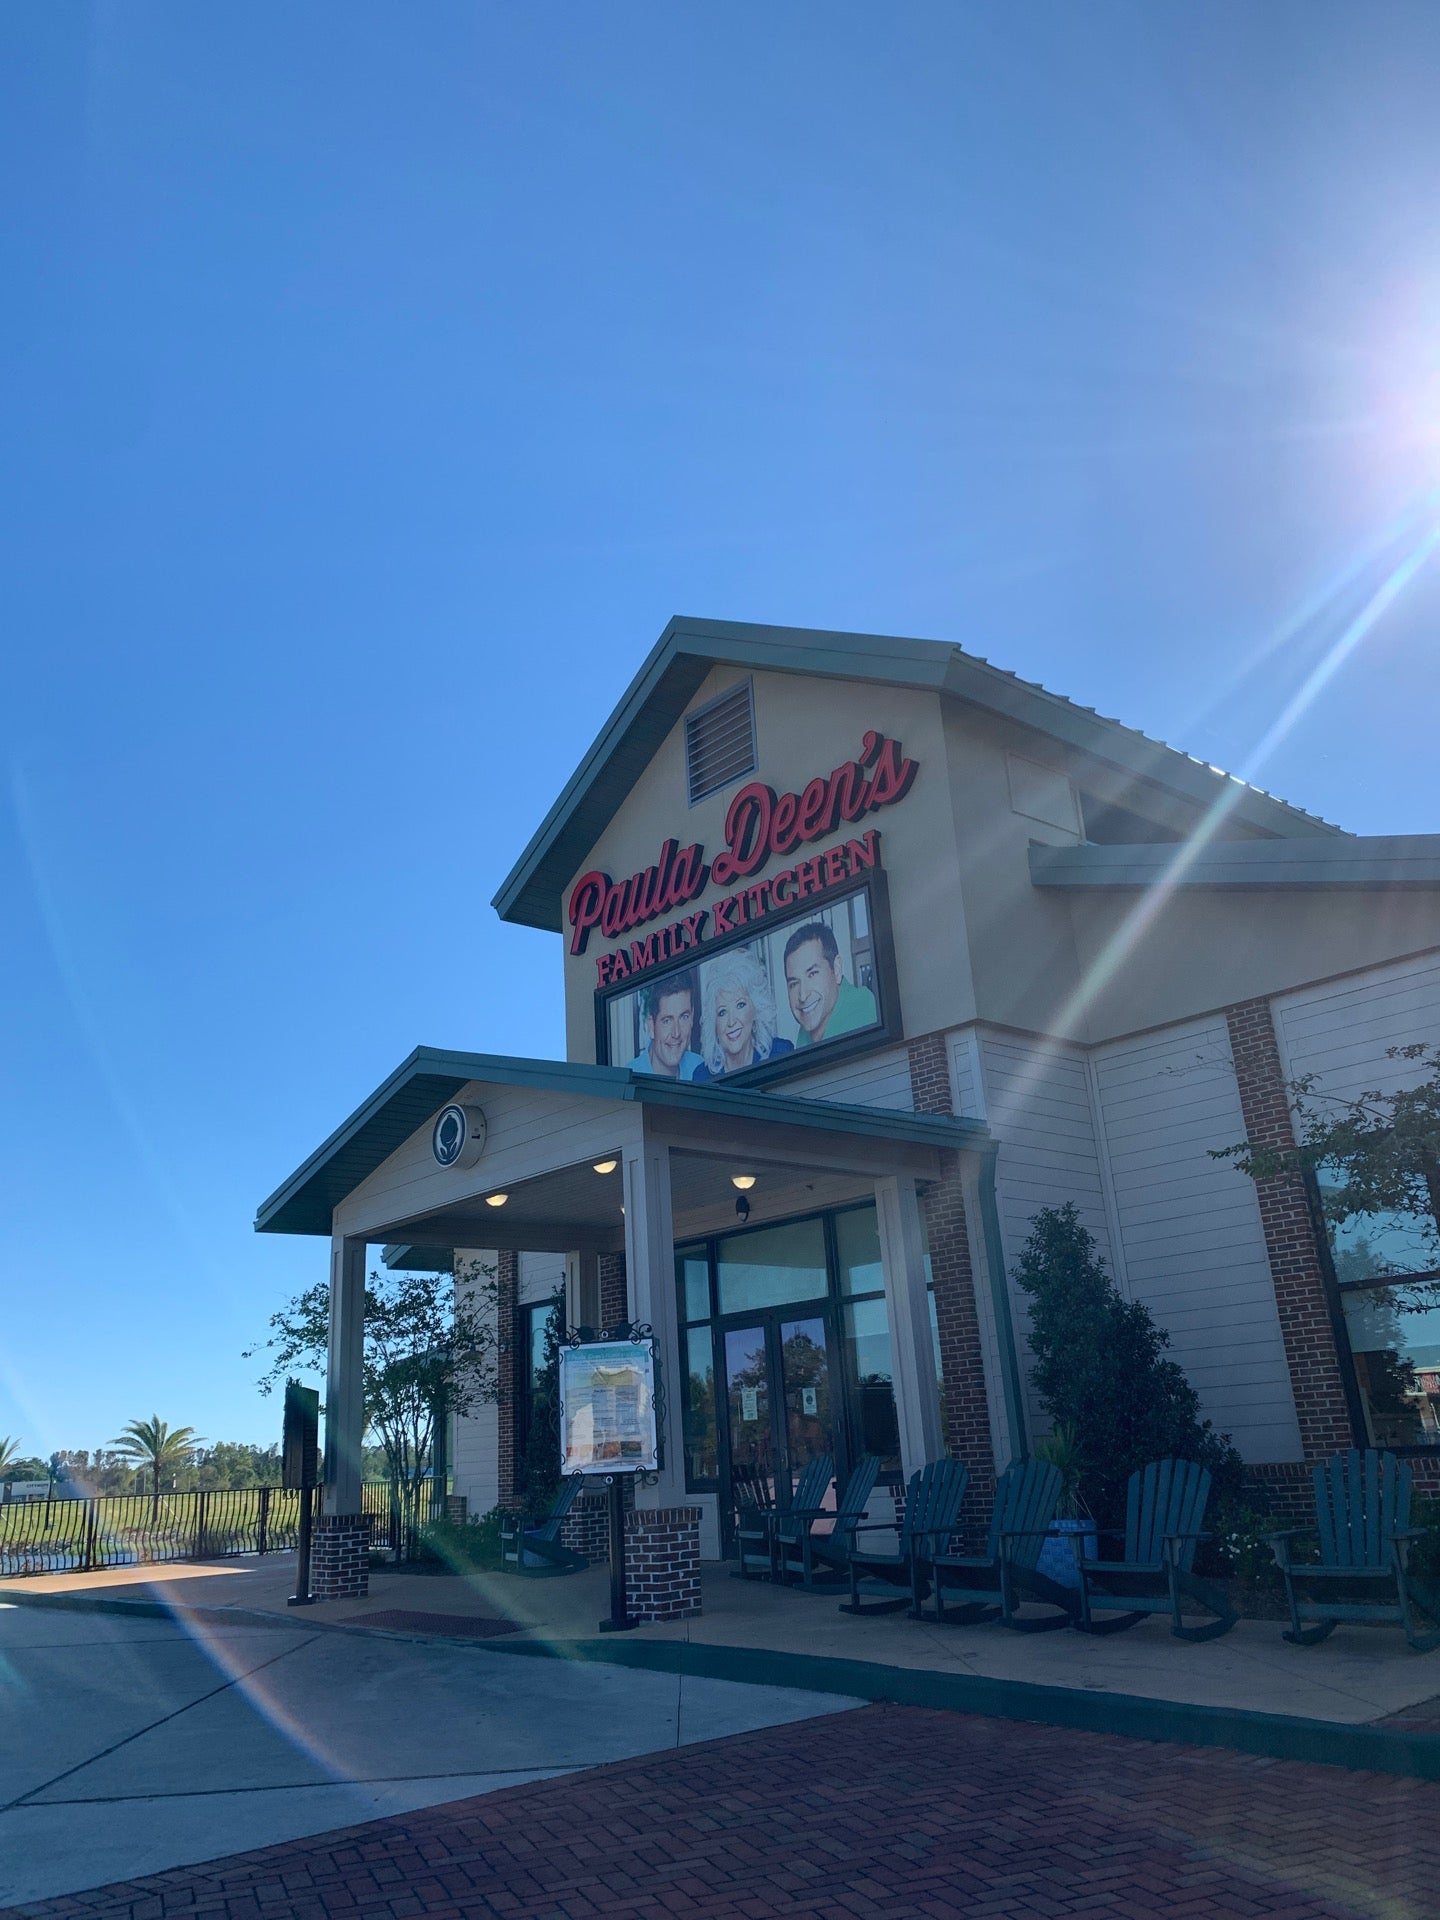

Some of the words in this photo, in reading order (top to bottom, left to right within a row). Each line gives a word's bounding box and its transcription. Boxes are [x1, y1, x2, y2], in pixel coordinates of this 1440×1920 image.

[569, 839, 711, 956] Paula
[712, 730, 919, 886] Deen's
[596, 910, 709, 988] FAMILY
[712, 829, 881, 937] KITCHEN
